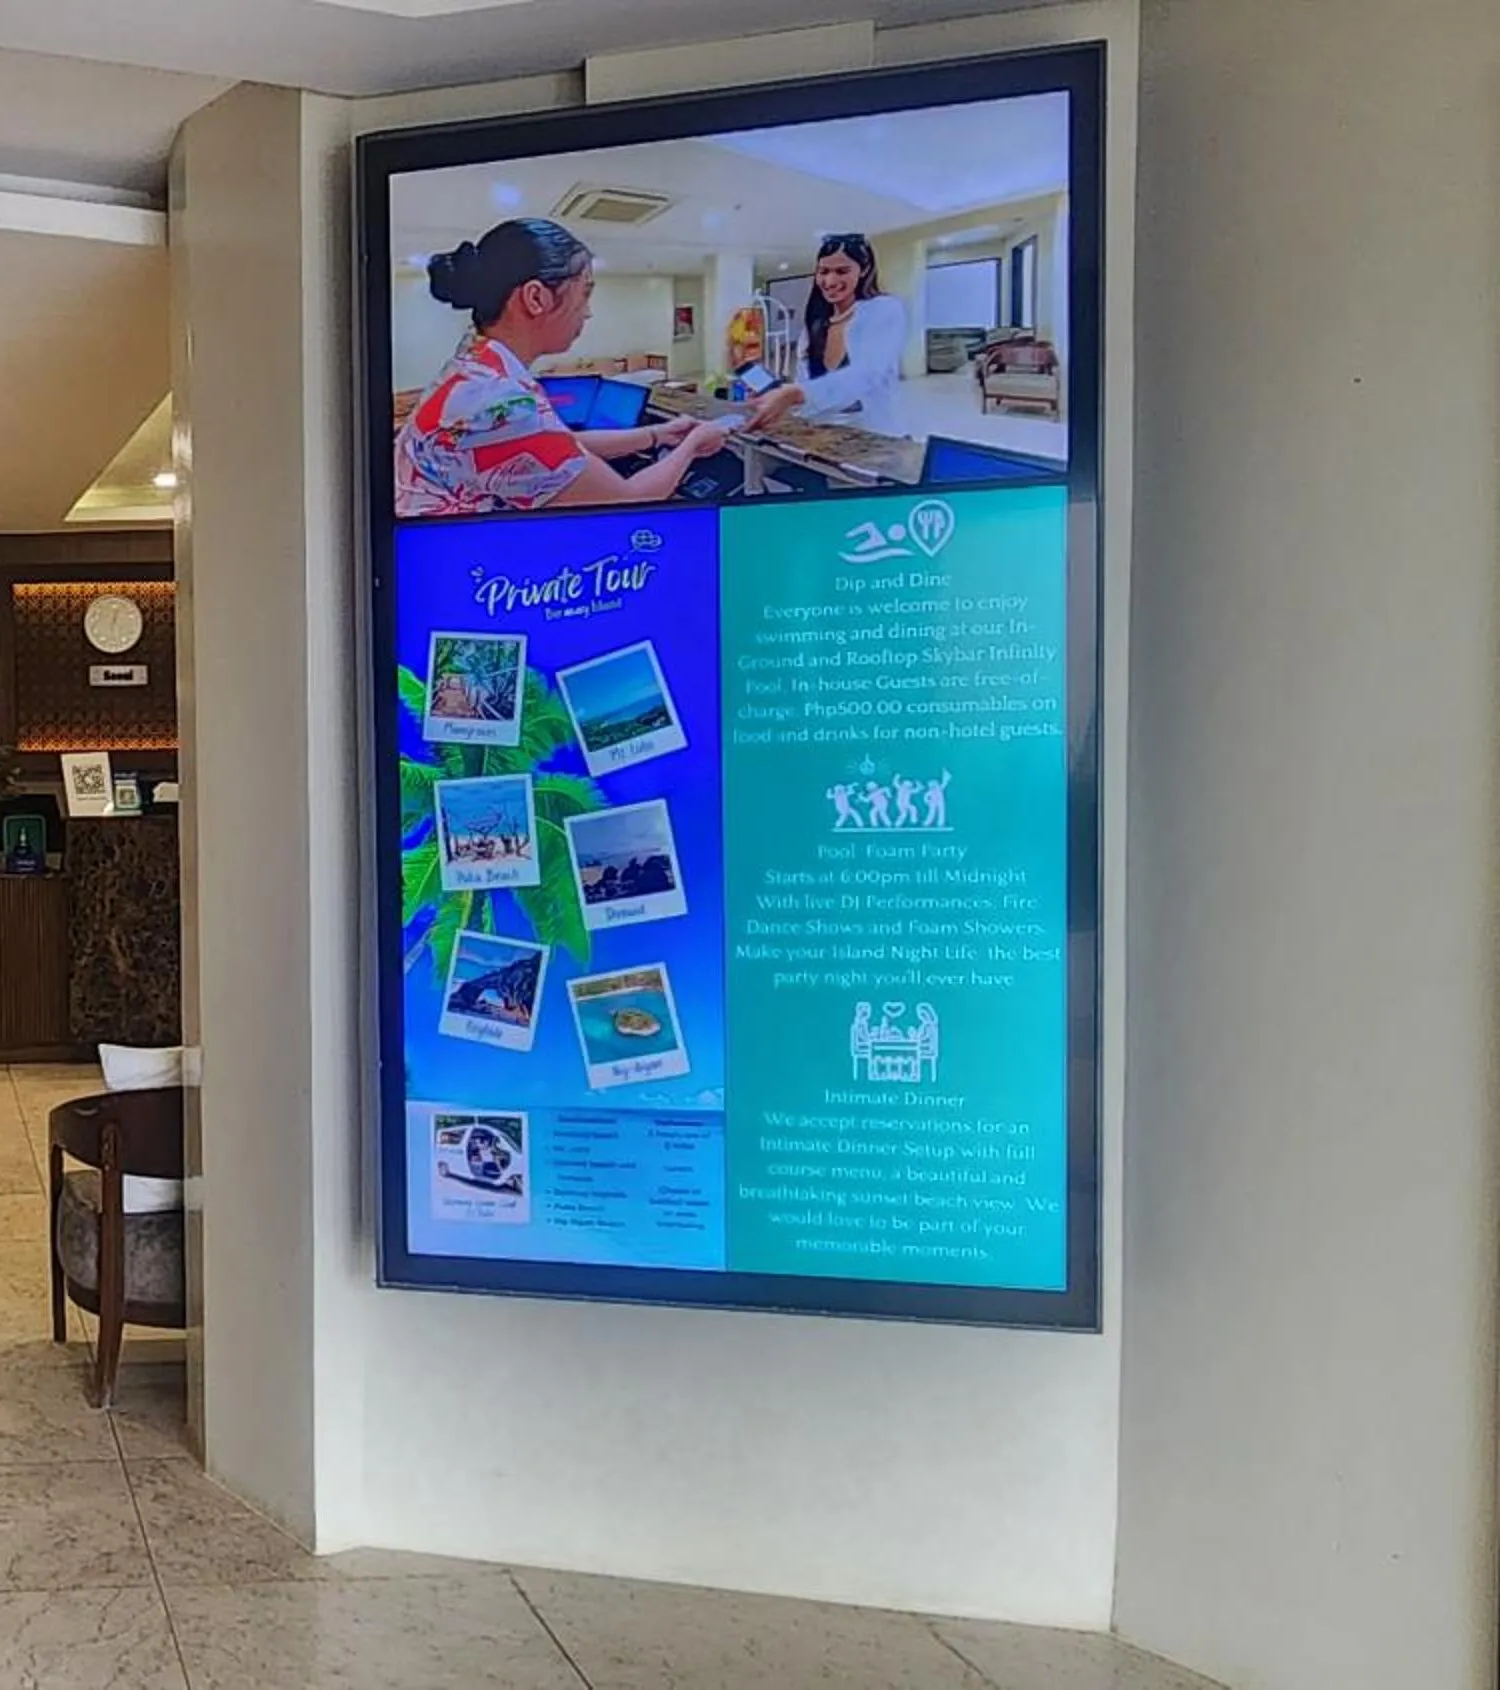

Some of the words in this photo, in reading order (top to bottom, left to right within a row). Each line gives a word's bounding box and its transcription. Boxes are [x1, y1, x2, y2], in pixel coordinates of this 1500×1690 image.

[475, 567, 583, 616] Private
[583, 555, 656, 597] Tour
[835, 576, 866, 593] Dip
[871, 574, 904, 589] and
[910, 573, 951, 587] Dine
[763, 603, 845, 621] Everyone
[850, 601, 862, 615] is
[868, 597, 949, 615] welcome
[955, 597, 972, 611] to
[977, 595, 1028, 614] enjoy
[756, 627, 846, 645] swimming
[850, 625, 883, 640] and
[888, 623, 945, 640] dining
[951, 623, 968, 636] at
[974, 623, 1002, 636] our
[738, 653, 804, 670] Ground
[808, 651, 841, 667] and
[847, 649, 917, 669] Rooftop
[922, 646, 984, 666] Skybar
[990, 645, 1057, 663] Infinity
[876, 674, 937, 689] Guests
[940, 674, 968, 688] are
[804, 701, 901, 718] Php500.00
[906, 697, 1028, 713] consumables
[1032, 698, 1057, 710] on
[778, 727, 809, 742] and
[813, 726, 869, 741] drinks
[873, 726, 899, 740] for
[904, 723, 995, 738] non-hotel
[866, 845, 914, 859] Foam
[921, 845, 968, 862] Party
[766, 870, 815, 885] Starts
[820, 872, 834, 883] at
[915, 870, 939, 883] till
[945, 869, 1027, 887] Midnight
[757, 895, 799, 909] With
[805, 895, 834, 909] live
[841, 896, 858, 911] DJ
[1002, 896, 1037, 909] Fire
[747, 920, 801, 935] Dance
[806, 920, 864, 934] Shows
[869, 920, 901, 934] and
[908, 920, 958, 934] Foam
[736, 946, 782, 960] Make
[786, 947, 826, 962] your
[832, 946, 885, 960] Island
[891, 946, 939, 962] Night
[988, 946, 1015, 960] the
[1023, 946, 1060, 961] best
[774, 972, 819, 988] party
[824, 971, 867, 987] night
[926, 973, 965, 986] ever
[825, 1089, 899, 1105] Intimate
[904, 1091, 965, 1107] Dinner
[763, 1111, 796, 1126] We
[800, 1112, 855, 1131] accept
[861, 1113, 971, 1133] reservations
[977, 1117, 1003, 1133] for
[1008, 1122, 1029, 1133] an
[760, 1137, 831, 1153] Intimate
[838, 1140, 897, 1155] Dinner
[904, 1142, 952, 1159] Setup
[961, 1144, 999, 1158] with
[1005, 1145, 1035, 1159] full
[767, 1163, 825, 1178] course
[907, 1166, 986, 1183] beautiful
[991, 1169, 1025, 1185] and
[739, 1184, 847, 1205] breathtaking
[851, 1189, 907, 1205] sunset
[915, 1191, 967, 1208] beach
[1025, 1196, 1060, 1213] We
[769, 1210, 823, 1225] would
[828, 1212, 863, 1227] love
[870, 1214, 886, 1228] to
[892, 1215, 910, 1229] be
[918, 1218, 952, 1233] part
[961, 1220, 979, 1233] of
[983, 1223, 1027, 1238] your
[796, 1238, 896, 1255] memorable
